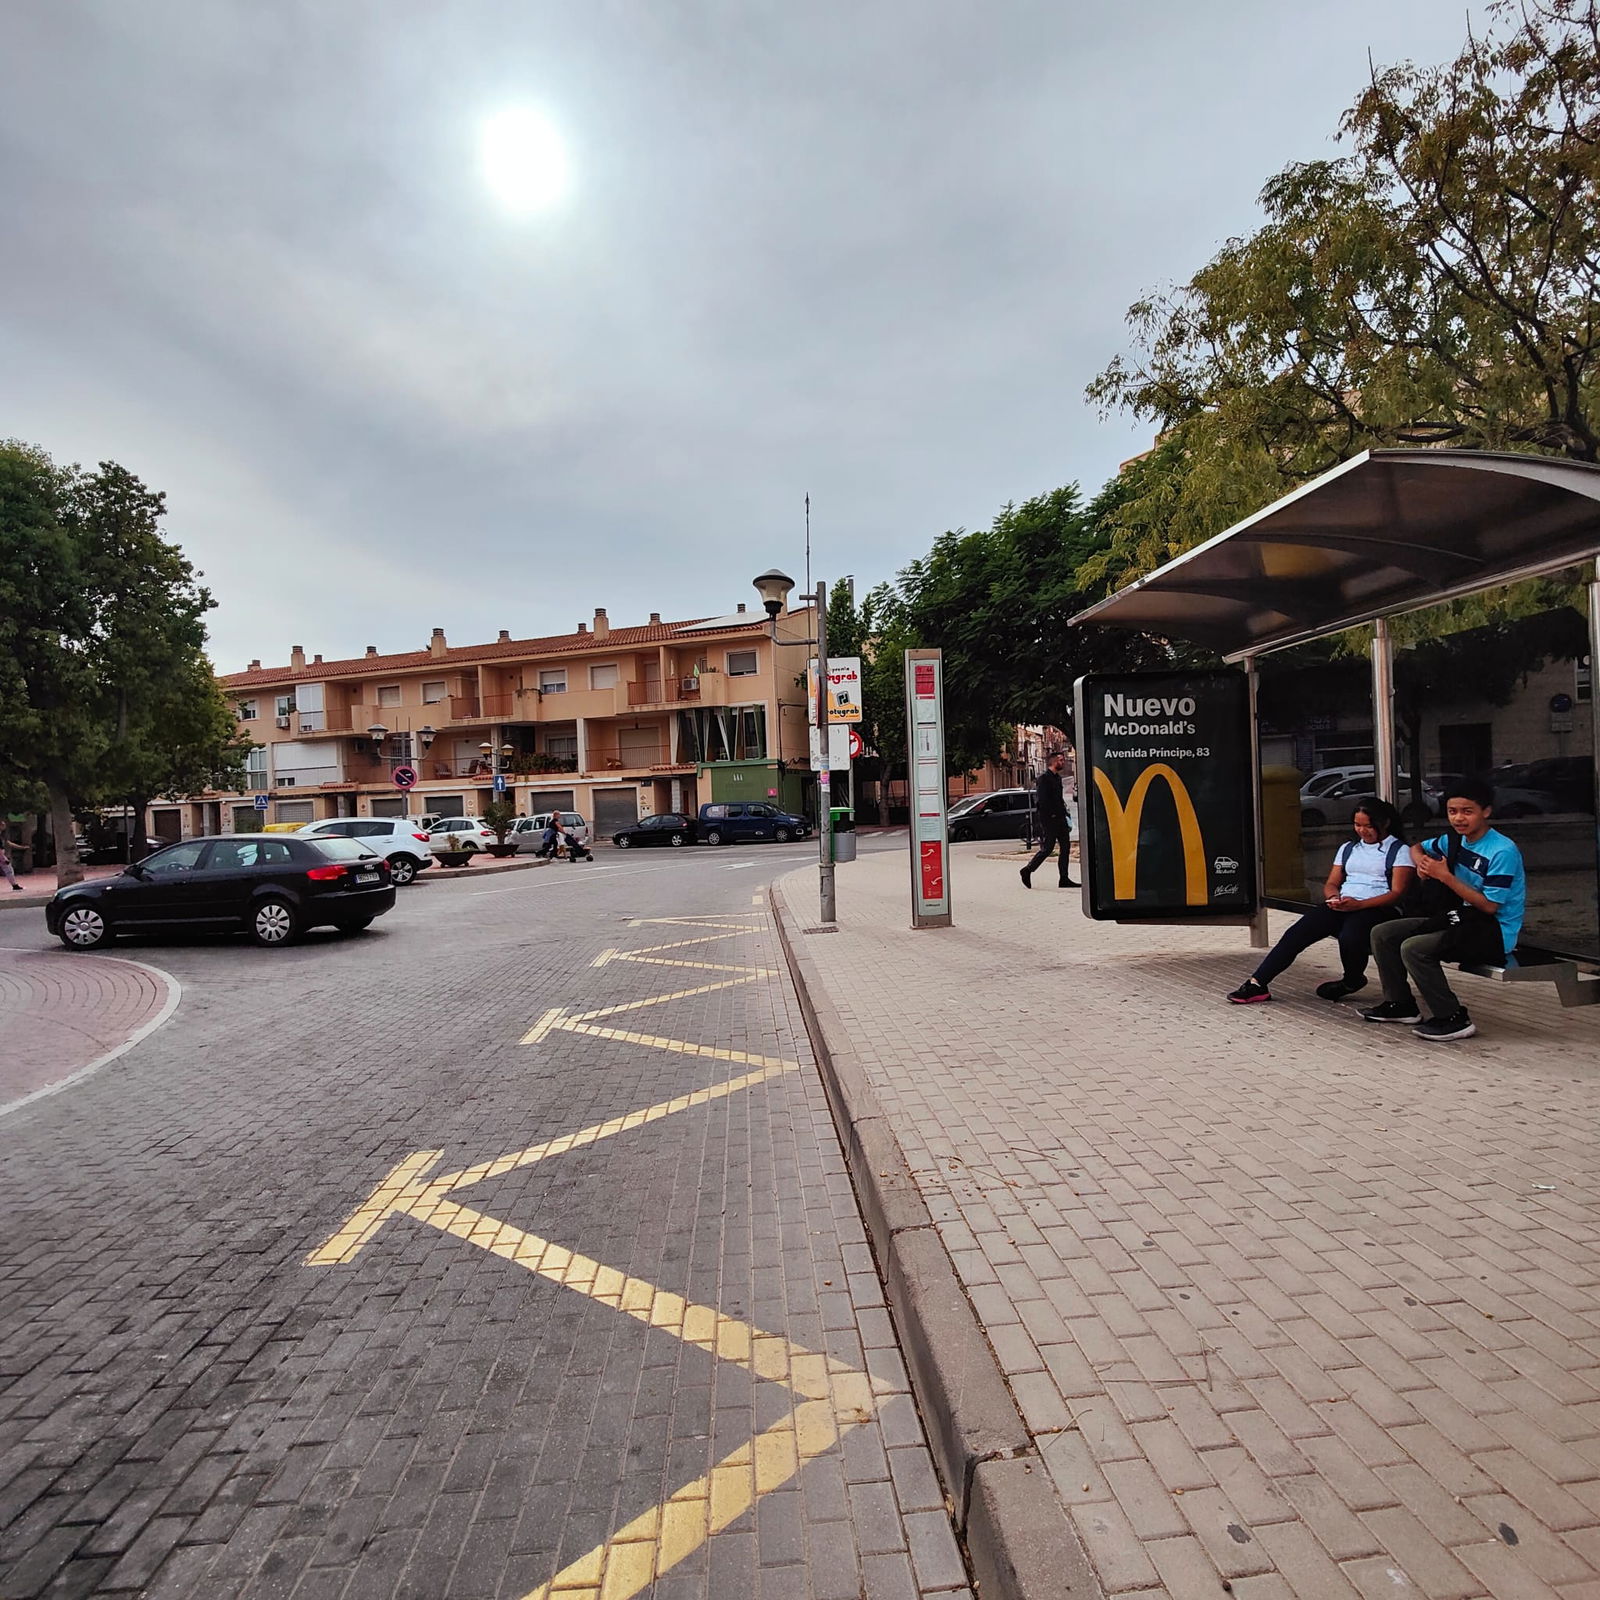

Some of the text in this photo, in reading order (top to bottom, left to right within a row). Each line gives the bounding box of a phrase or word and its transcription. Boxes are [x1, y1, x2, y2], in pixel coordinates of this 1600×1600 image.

[1104, 693, 1196, 717] Nuevo
[1104, 748, 1147, 759] Avenida
[1196, 747, 1210, 757] 83
